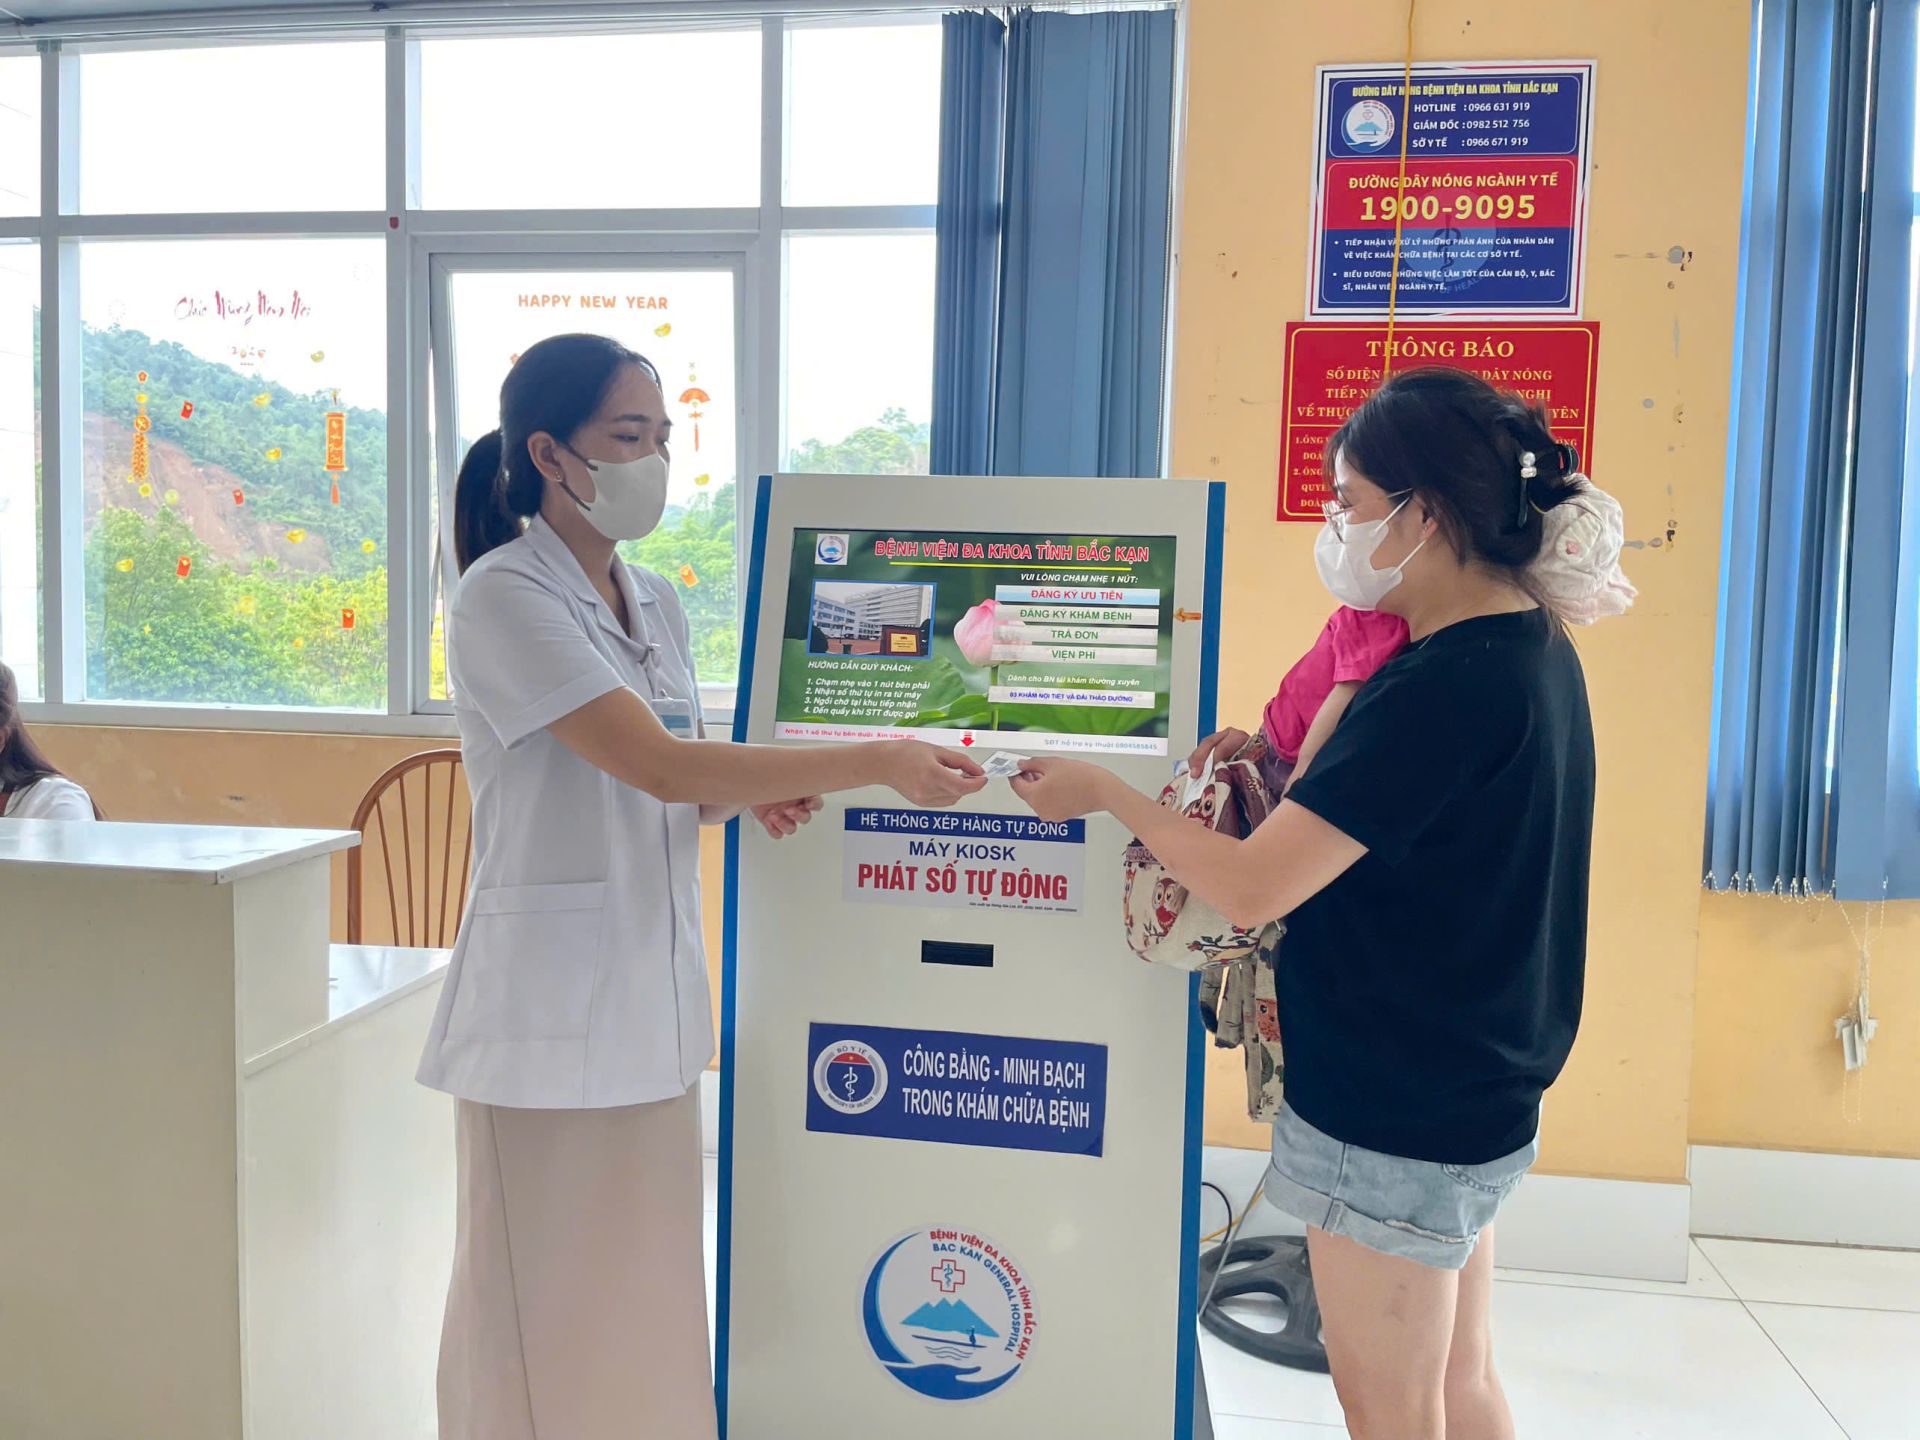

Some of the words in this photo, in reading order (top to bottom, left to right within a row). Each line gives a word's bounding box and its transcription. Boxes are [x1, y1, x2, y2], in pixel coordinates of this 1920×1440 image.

[1399, 85, 1420, 96] NNG
[1423, 83, 1445, 97] BỆNH
[1446, 83, 1465, 97] VIỆN
[1479, 83, 1501, 94] KHOA
[1503, 80, 1522, 94] TỈNH
[1523, 79, 1540, 94] BẮC
[1541, 82, 1559, 95] KẠN
[1414, 103, 1457, 113] HOTLINE
[1493, 102, 1510, 112] 631
[1512, 102, 1531, 111] 919
[1413, 119, 1438, 130] GIÁM
[1439, 119, 1460, 130] ĐỐC
[1492, 119, 1509, 129] 512
[1512, 119, 1530, 129] 756
[1412, 137, 1426, 148] SỞ
[1427, 138, 1435, 148] Y
[1435, 136, 1448, 148] TẾ
[1491, 137, 1508, 147] 671
[1511, 137, 1529, 147] 919
[1348, 173, 1400, 190] ĐƯỜNG
[1403, 173, 1430, 189] DÂY
[1431, 172, 1473, 188] NÓNG
[1476, 172, 1526, 187] NGÀNH
[1530, 174, 1540, 187] Y
[1540, 171, 1559, 186] TẾ
[1360, 194, 1536, 221] 1900-9095
[1344, 238, 1363, 246] TIẾP
[1363, 237, 1386, 248] NHẬN
[1495, 236, 1512, 245] CỦA
[1513, 236, 1536, 245] NHÂN
[1537, 236, 1555, 245] DÂN
[1355, 251, 1374, 261] VIỆC
[1460, 250, 1476, 258] CÁC
[1477, 250, 1489, 258] CƠ
[1490, 250, 1502, 258] SỞ
[1509, 249, 1522, 258] TẾ.
[1363, 270, 1392, 278] DƯƠNG
[1424, 270, 1442, 279] VIỆC
[1462, 269, 1477, 278] TỐT
[1478, 268, 1495, 278] CỦA
[1496, 269, 1512, 277] CÁN
[1514, 269, 1529, 279] BỘ,
[1530, 270, 1538, 278] Y,
[1539, 268, 1556, 277] BÁC
[1355, 283, 1378, 291] NHÂN
[1398, 282, 1426, 291] NGÀNH
[517, 293, 572, 308] HAPPY
[580, 295, 617, 309] NEW
[625, 296, 669, 310] YEAR
[1366, 335, 1456, 357] THÔNG
[1461, 336, 1515, 358] BÁO
[1326, 365, 1345, 380] SỐ
[1482, 367, 1510, 381] DÂY
[1512, 367, 1553, 381] NÓNG
[1325, 384, 1358, 399] TIẾP
[874, 537, 919, 561] BỆNH
[921, 538, 959, 561] VIỆN
[962, 543, 985, 560] ĐA
[987, 542, 1033, 561] KHOA
[1035, 540, 1073, 561] TỈNH
[1075, 538, 1112, 562] BẮC
[1114, 546, 1150, 565] KẠN
[1020, 573, 1036, 582] VUI
[1036, 572, 1061, 582] LÒNG
[1062, 573, 1089, 584] CHẠM
[1090, 574, 1108, 585] NHẸ
[1111, 575, 1115, 583] 1
[1117, 574, 1139, 584] NÚT:
[1031, 589, 1061, 599] ĐĂNG
[1063, 589, 1078, 600] KÝ
[1080, 591, 1097, 600] ƯU
[1100, 590, 1123, 601] TIÊN
[1020, 608, 1050, 618] ĐĂNG
[1052, 608, 1067, 619] KÝ
[1069, 609, 1100, 620] KHÁM
[1103, 610, 1132, 623] BỆNH
[1051, 629, 1072, 639] TRẢ
[1075, 630, 1099, 640] ĐƠN
[1051, 649, 1076, 662] VIỆN
[1078, 650, 1096, 660] PHÍ
[807, 660, 839, 670] HƯỚNG
[840, 659, 860, 670] DẪN
[860, 662, 879, 671] QUÝ
[880, 661, 913, 672] KHÁCH:
[815, 678, 839, 688] Chạm
[840, 679, 855, 688] nhẹ
[1028, 675, 1043, 683] cho
[1043, 675, 1056, 683] BN
[804, 697, 812, 705] 3.
[863, 698, 878, 707] khu
[866, 708, 883, 717] STT
[860, 811, 879, 829] HỆ
[882, 812, 930, 830] THỐNG
[932, 814, 959, 831] XẾP
[962, 815, 1001, 833] HÀNG
[1005, 818, 1025, 838] TỰ
[908, 837, 951, 857] MÁY
[956, 843, 1016, 862] KIOSK
[857, 860, 919, 892] PHÁT
[925, 859, 959, 895] SỐ
[964, 867, 998, 901] TỰ
[1000, 867, 1068, 904] ĐỘNG
[903, 1043, 945, 1079] CÔNG
[948, 1047, 991, 1082] BẰNG
[1003, 1056, 1040, 1086] MINH
[1043, 1060, 1085, 1095] BẠCH
[902, 1087, 953, 1118] TRONG
[956, 1086, 999, 1121] KHÁM
[1003, 1091, 1046, 1125] CHỮA
[1049, 1096, 1090, 1134] BỆNH
[930, 1228, 958, 1242] BỆNH
[960, 1232, 984, 1249] VIỆN
[984, 1244, 999, 1260] ĐA
[998, 1256, 1023, 1286] KHOA
[932, 1243, 957, 1253] BAC
[959, 1245, 983, 1262] KAN
[983, 1258, 1017, 1302] GENERAL
[1004, 1303, 1021, 1353] HOSPITAL
